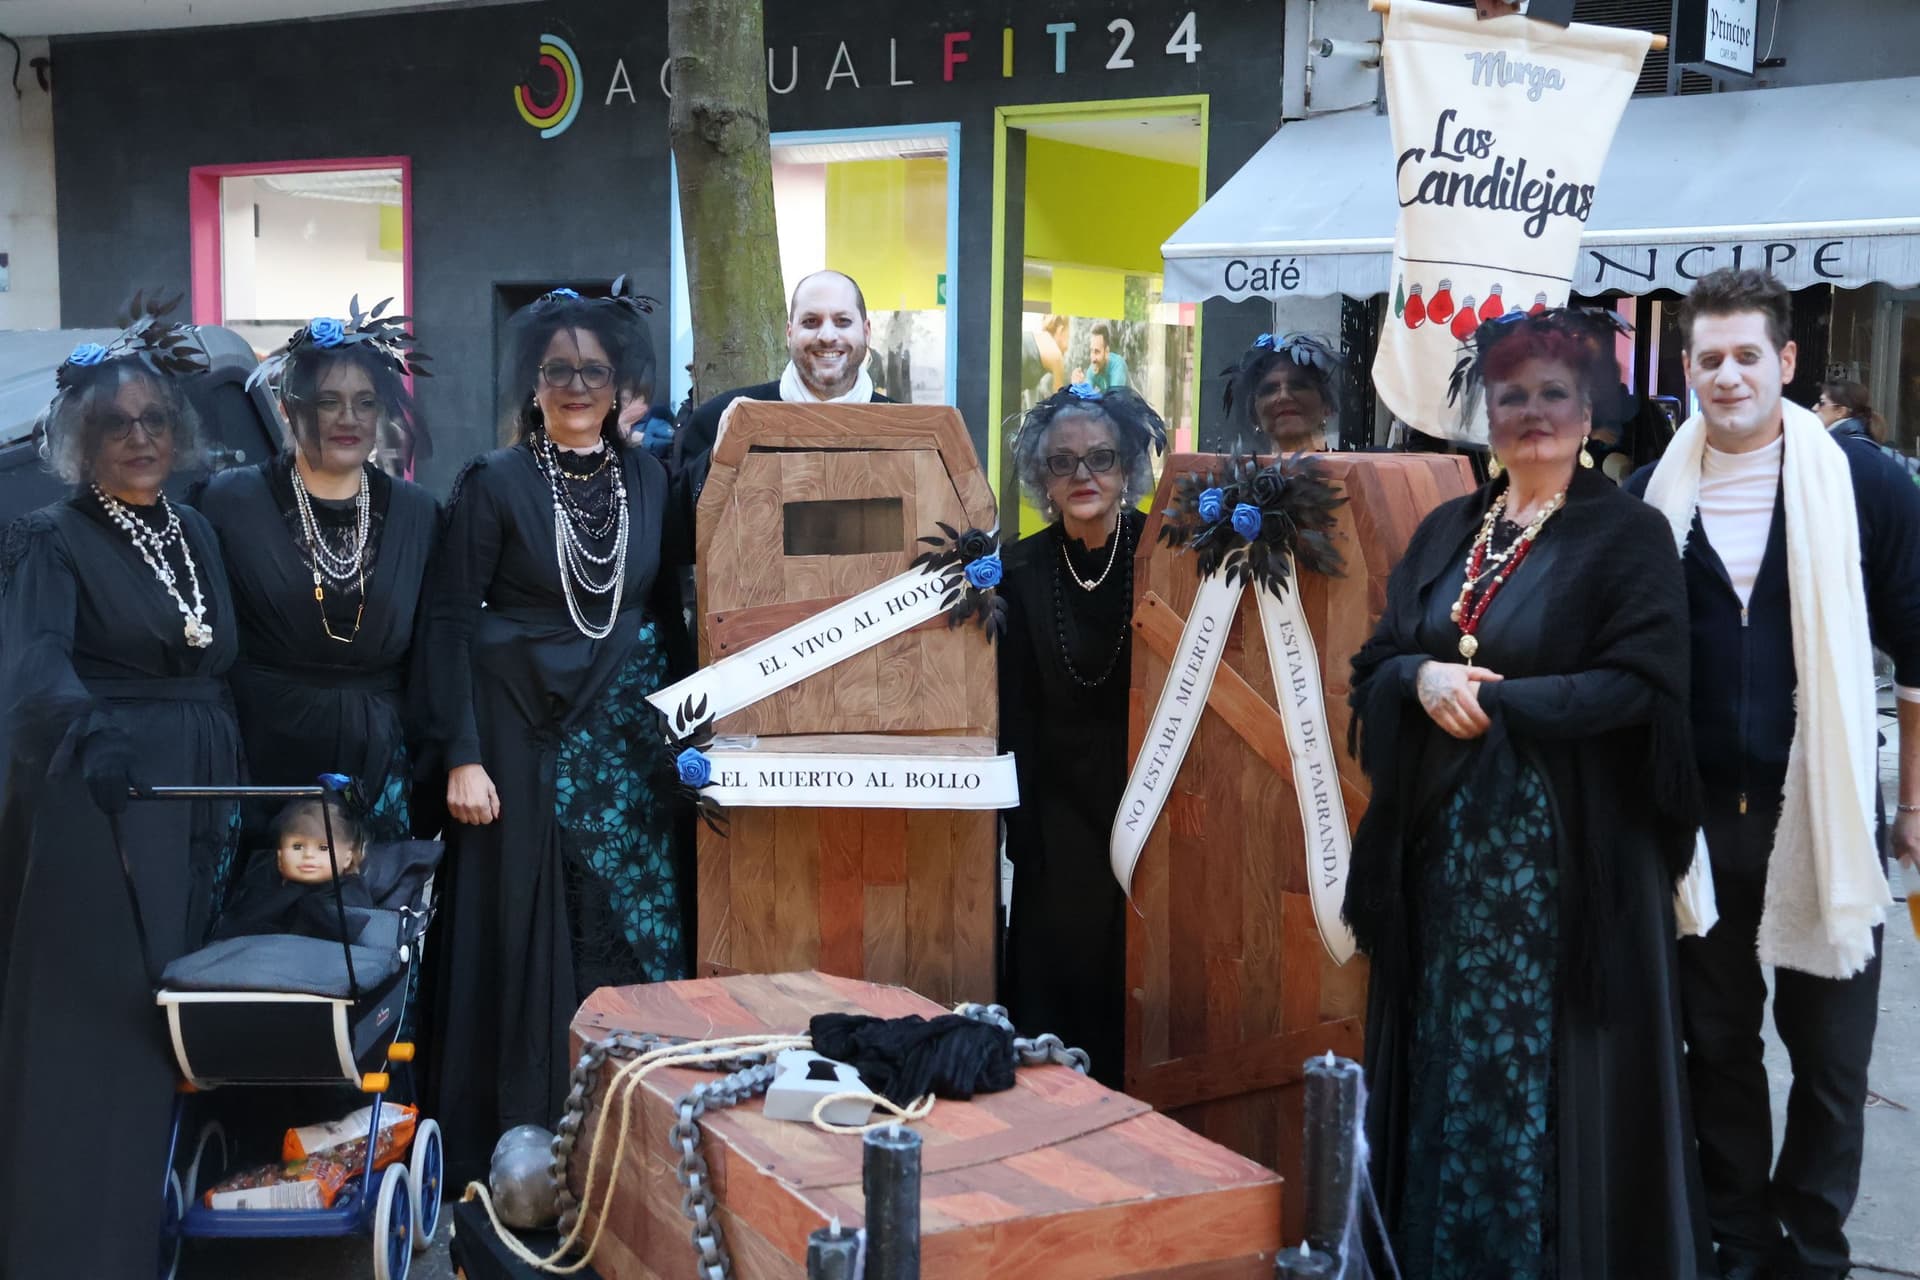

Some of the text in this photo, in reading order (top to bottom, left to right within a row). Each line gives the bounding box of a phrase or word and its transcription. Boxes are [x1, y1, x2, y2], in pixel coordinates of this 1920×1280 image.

[1464, 50, 1566, 102] Murga
[1430, 109, 1497, 162] Las
[1396, 148, 1596, 239] Candilejas
[1225, 241, 1844, 292] Café NCIPE
[758, 577, 946, 676] EL VIVO AL HOYO
[1125, 615, 1216, 832] NO ESTABA MUERTO
[1279, 620, 1338, 889] ESTABA DE PARRANDA
[720, 770, 981, 790] EL MUERTO AL BOLLO
